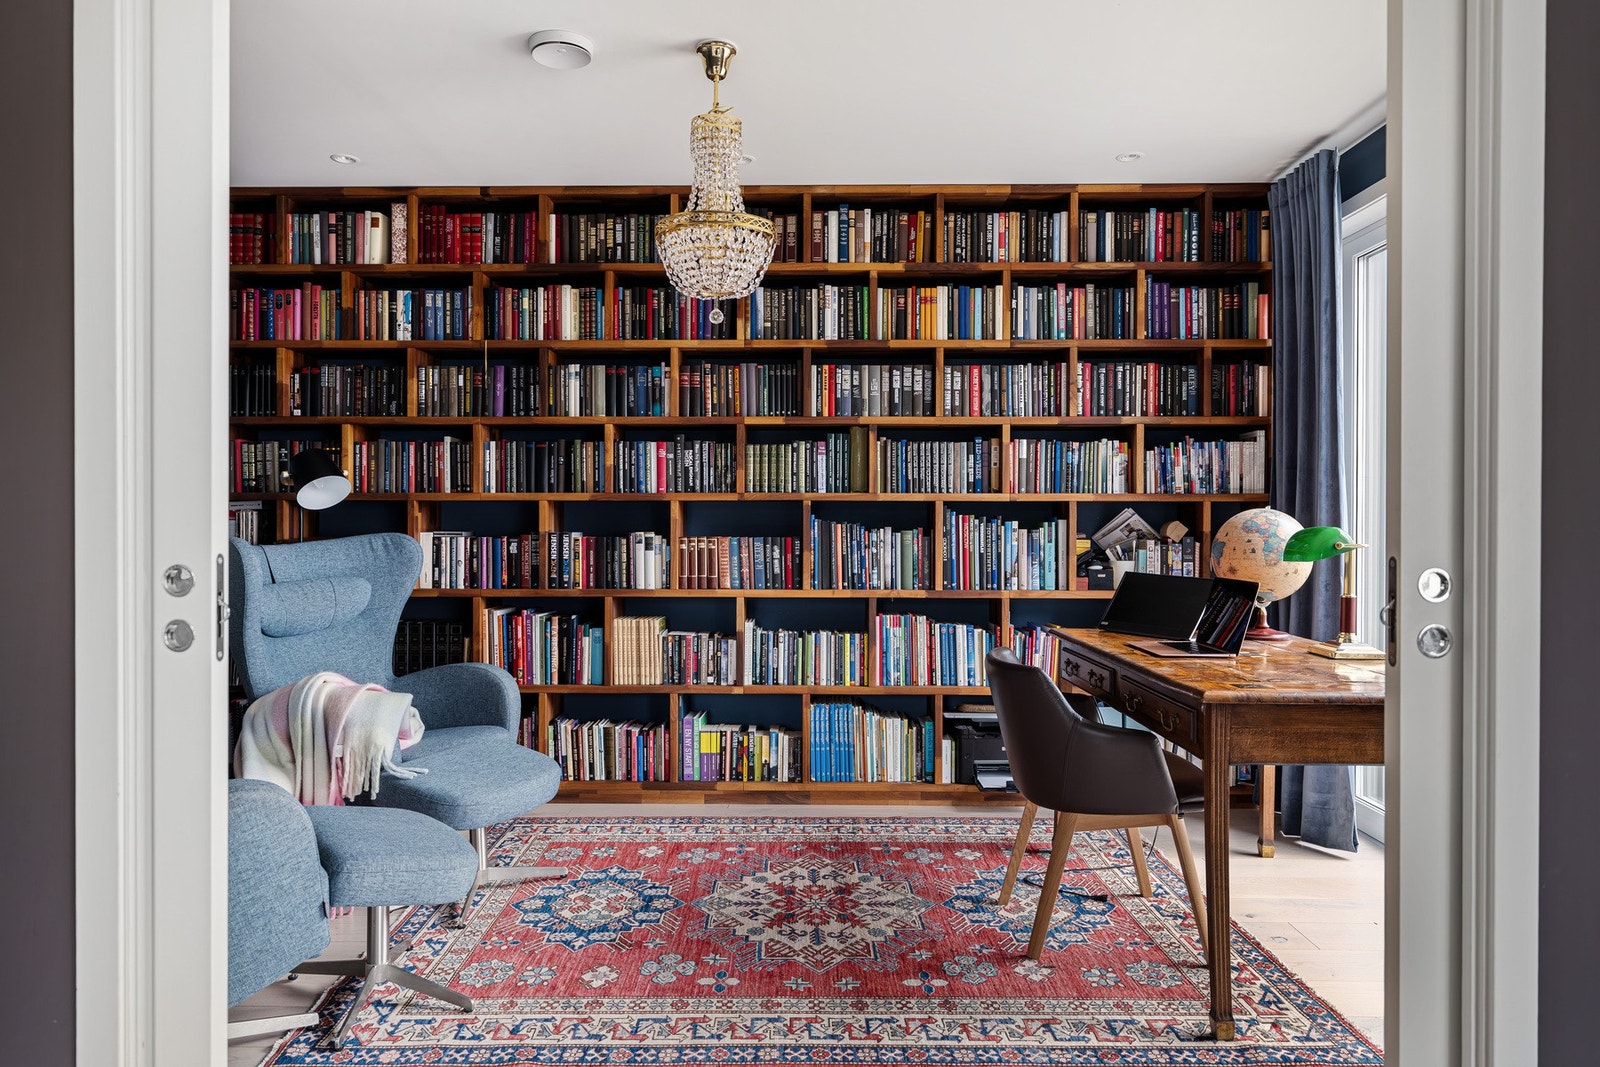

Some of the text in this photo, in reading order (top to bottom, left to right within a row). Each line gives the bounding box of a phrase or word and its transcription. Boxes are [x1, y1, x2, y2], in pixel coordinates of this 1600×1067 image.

[606, 218, 614, 229] DAN
[606, 230, 614, 247] BROWN
[944, 366, 951, 374] JO
[551, 625, 557, 637] LA
[685, 728, 692, 738] EN
[685, 738, 692, 747] NY
